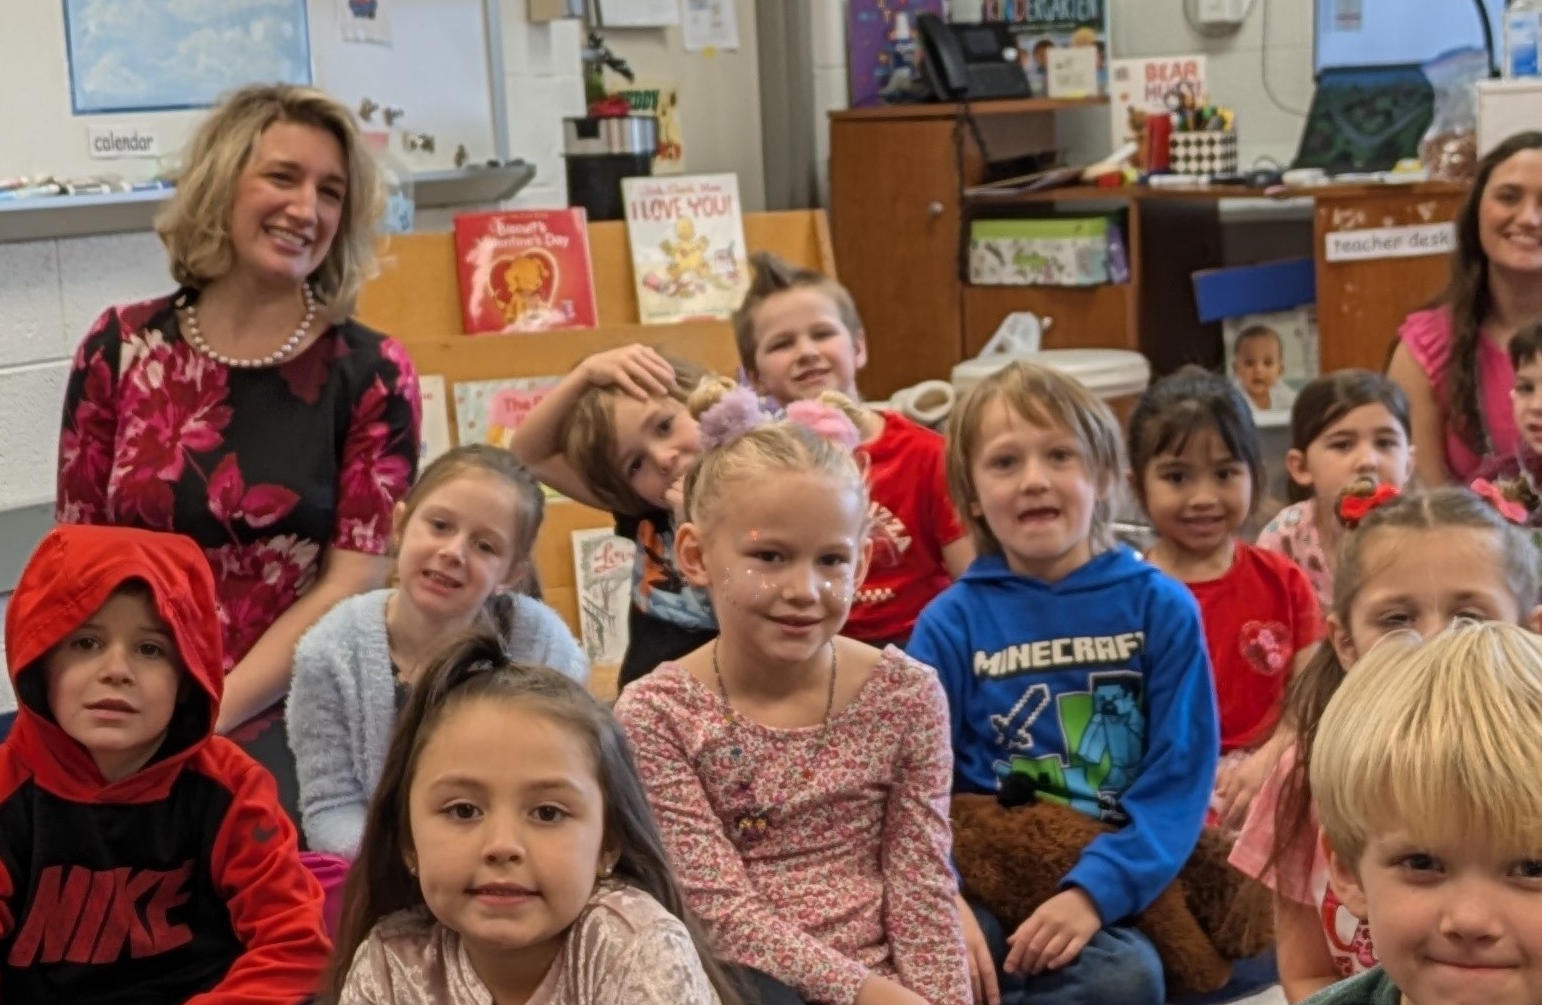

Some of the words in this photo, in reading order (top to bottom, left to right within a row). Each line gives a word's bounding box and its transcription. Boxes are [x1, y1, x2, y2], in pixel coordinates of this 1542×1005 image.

[1145, 61, 1198, 81] BEAR
[93, 130, 154, 152] calendar
[631, 201, 638, 220] I
[641, 197, 680, 220] LOVE
[688, 194, 732, 218] YOU!
[1334, 234, 1402, 254] teacher
[1409, 231, 1448, 249] desk
[7, 859, 195, 967] NIKE
